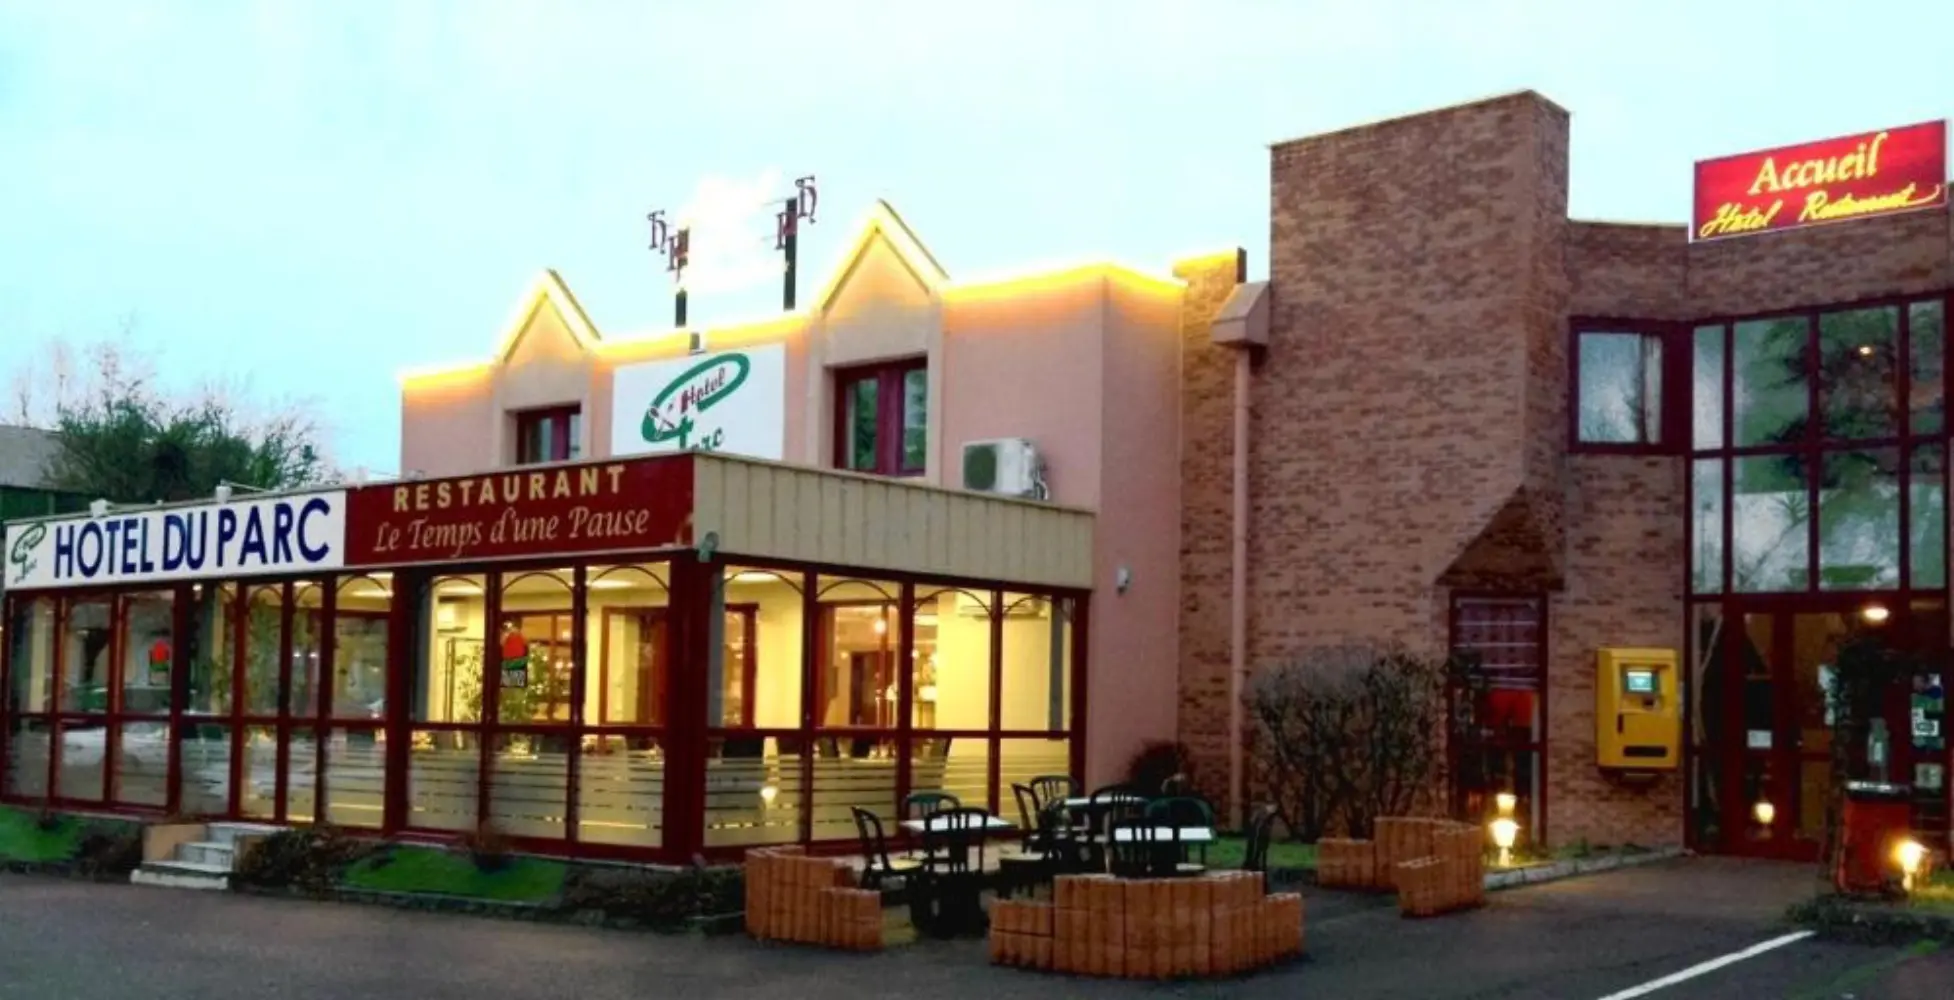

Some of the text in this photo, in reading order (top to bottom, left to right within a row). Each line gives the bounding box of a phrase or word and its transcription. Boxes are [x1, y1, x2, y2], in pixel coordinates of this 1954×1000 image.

[1748, 133, 1888, 195] Accueil
[394, 465, 626, 512] RESTAURANT
[54, 517, 154, 579] HOTEL
[162, 511, 208, 571] DU
[216, 498, 331, 567] PARC
[373, 507, 650, 557] Le Temps d'une Pause
